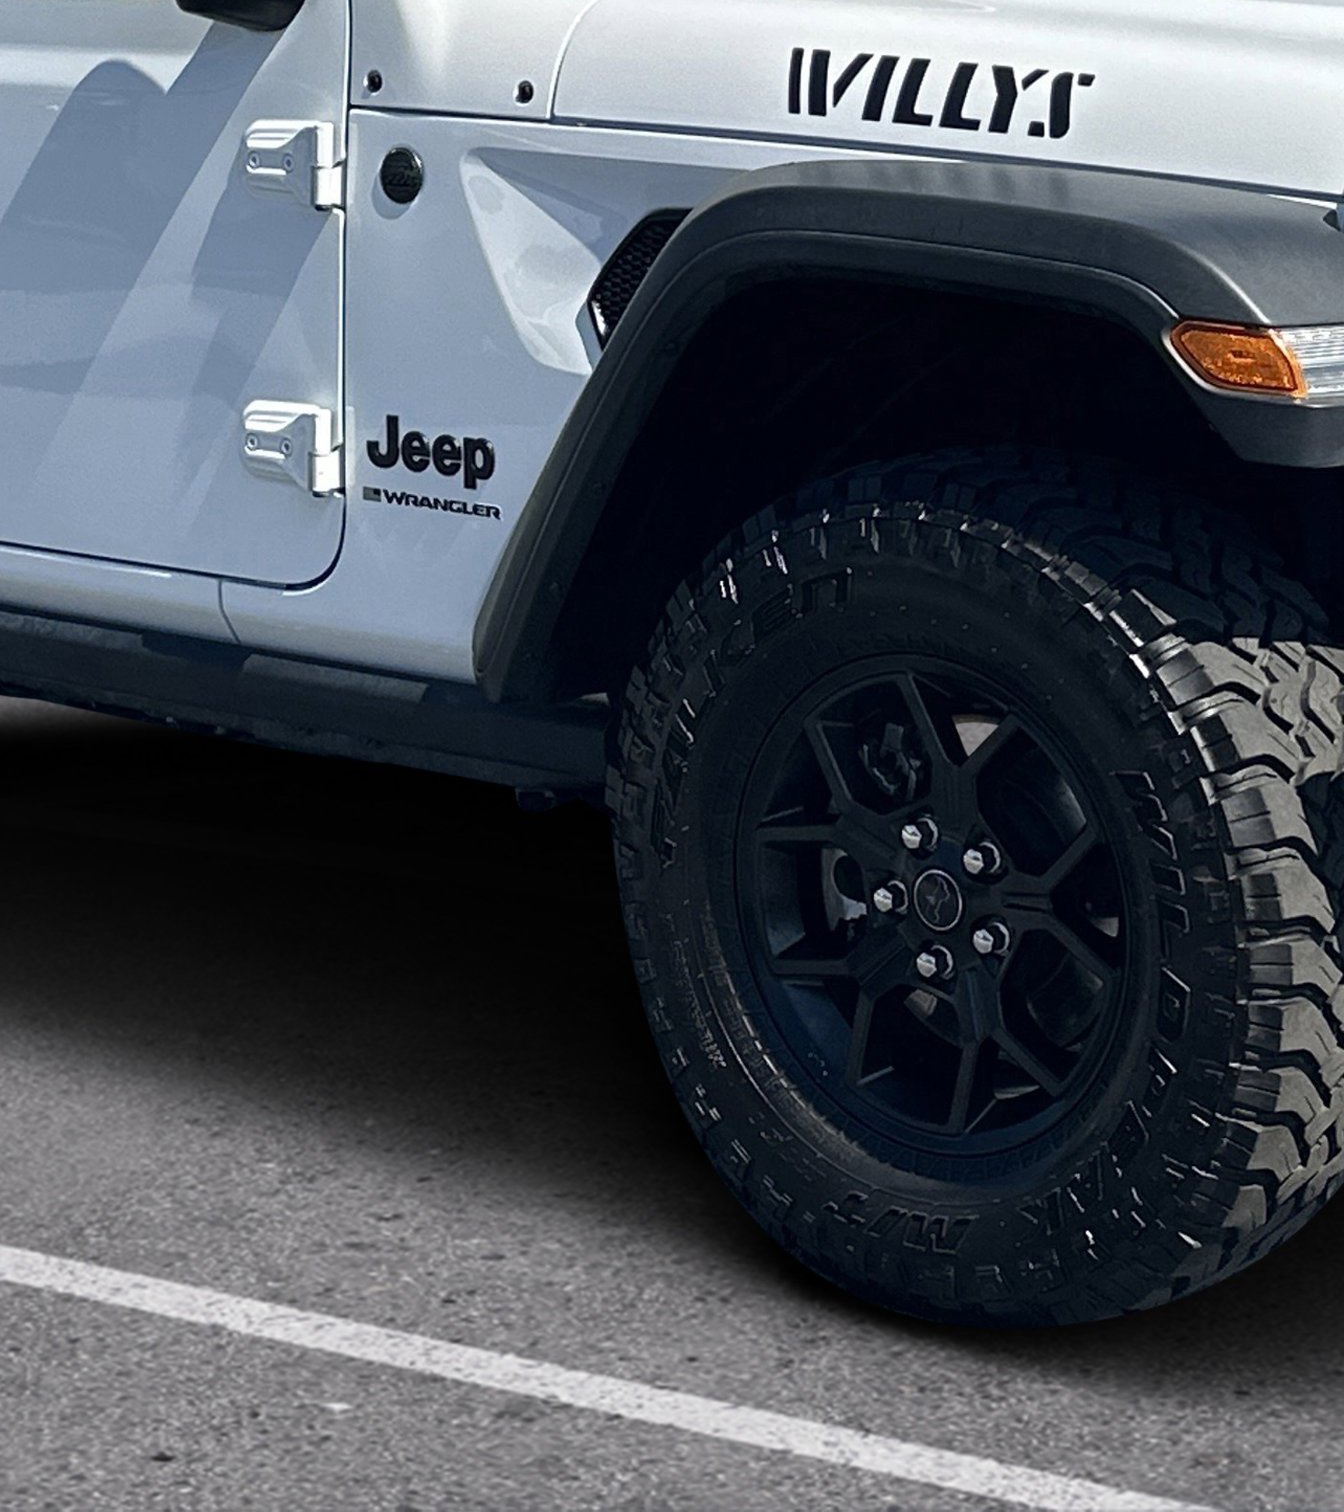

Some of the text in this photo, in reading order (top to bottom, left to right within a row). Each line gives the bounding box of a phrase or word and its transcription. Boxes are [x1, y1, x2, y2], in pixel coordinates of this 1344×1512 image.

[788, 47, 1096, 139] WILLYS
[366, 414, 495, 490] Jeep
[383, 489, 502, 520] WRANGLER
